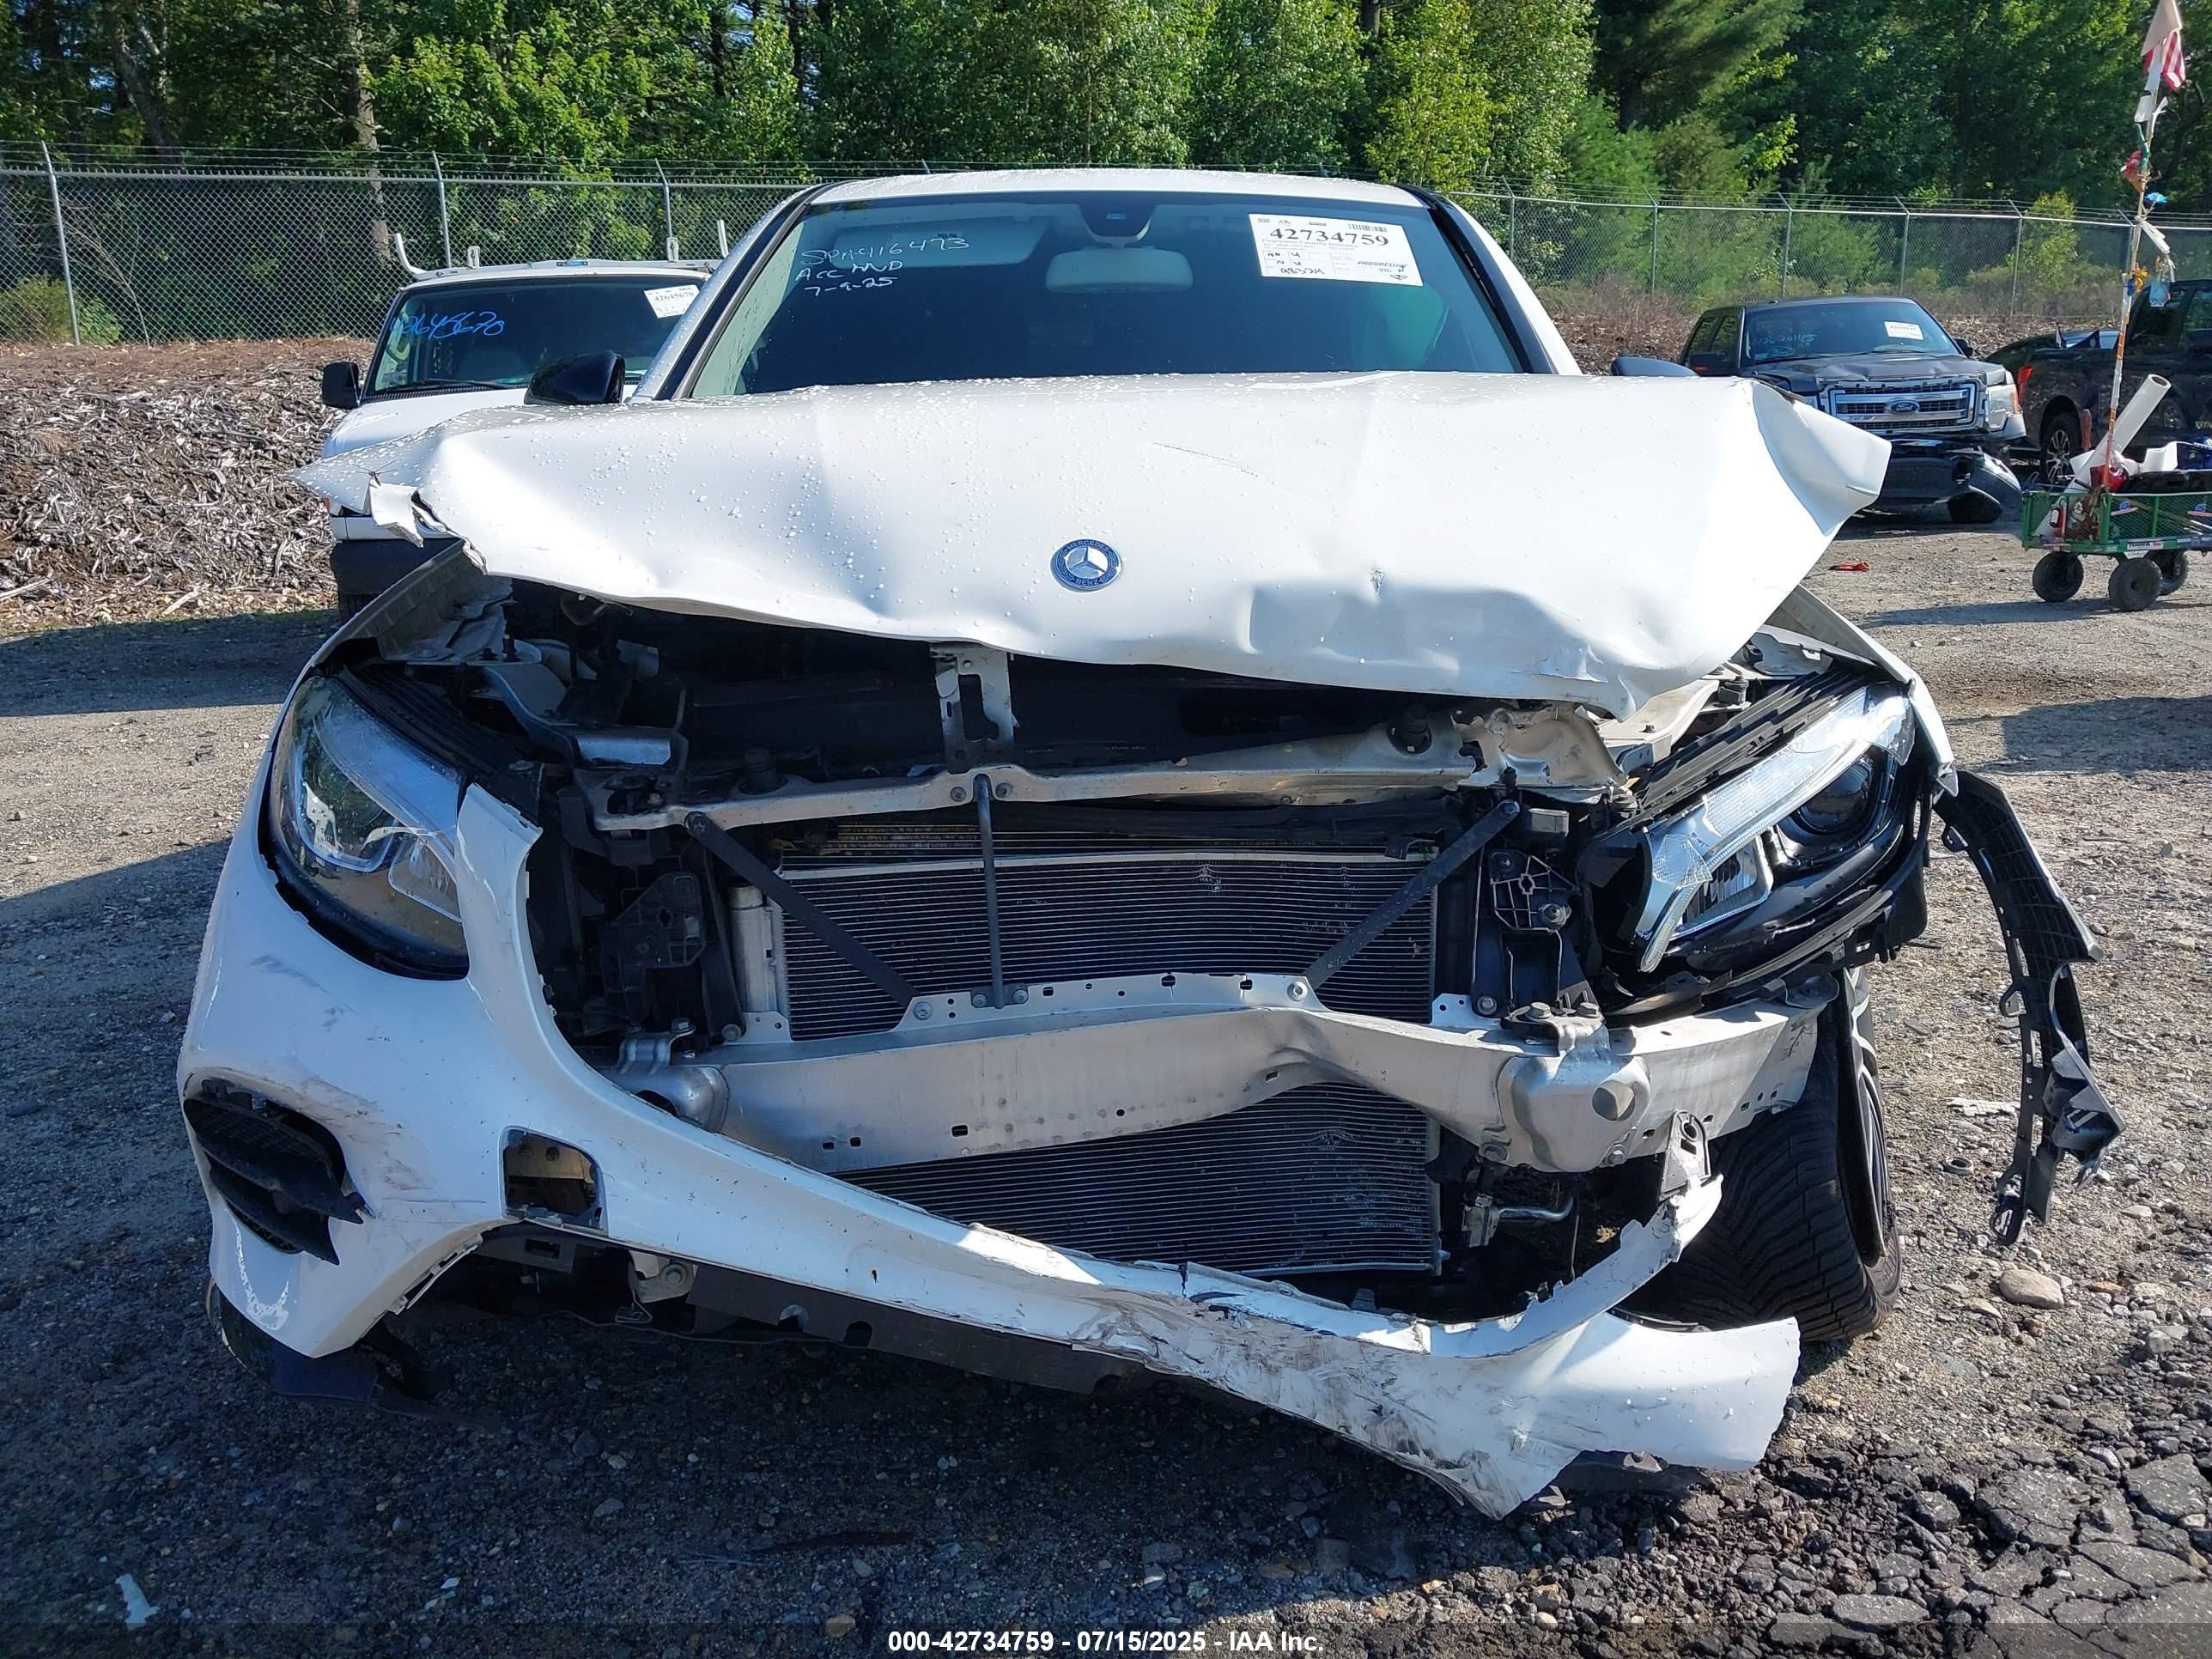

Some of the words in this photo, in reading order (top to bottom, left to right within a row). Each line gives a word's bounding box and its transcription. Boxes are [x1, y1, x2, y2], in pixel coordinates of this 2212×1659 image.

[1269, 228, 1389, 246] 42734759
[1895, 403, 1913, 411] Ford
[1066, 539, 1109, 552] MERCEDES
[1075, 578, 1100, 586] BENZ
